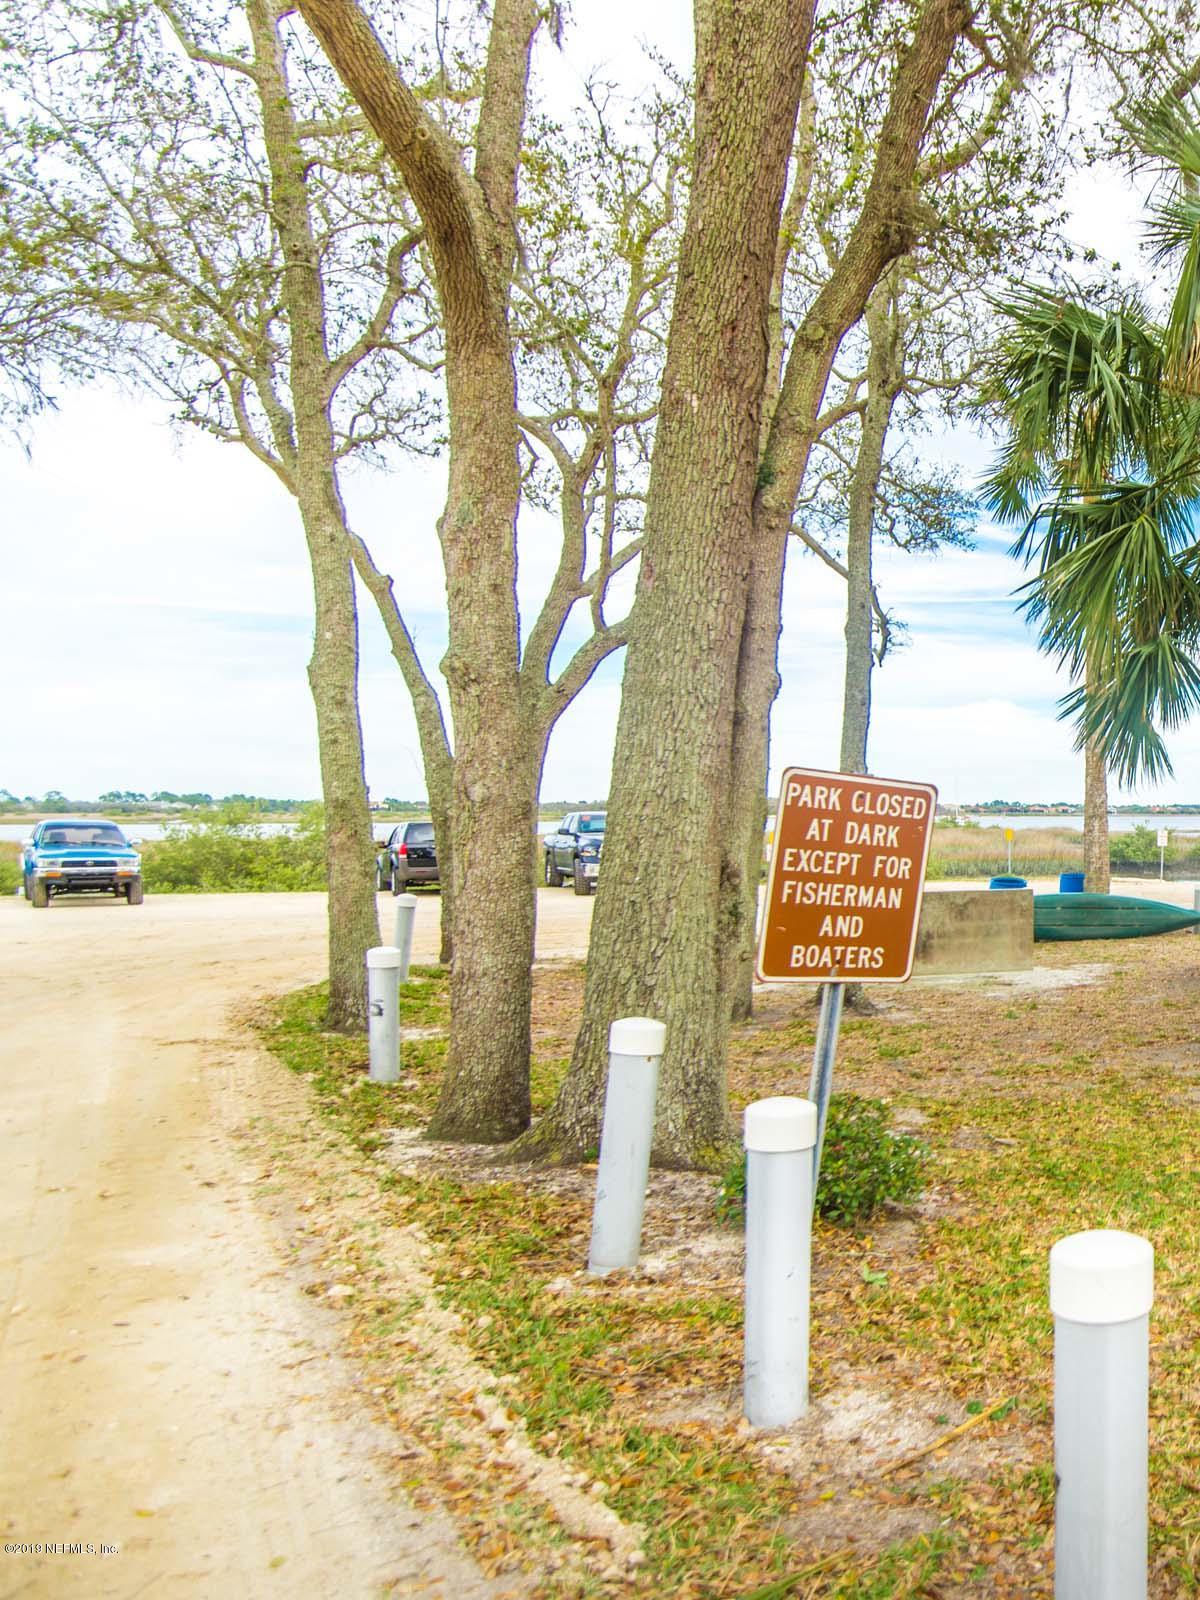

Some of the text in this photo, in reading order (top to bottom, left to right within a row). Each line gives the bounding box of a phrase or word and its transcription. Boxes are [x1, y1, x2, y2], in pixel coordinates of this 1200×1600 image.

[786, 783, 926, 820] PARK CLOSED
[805, 818, 900, 848] AT DARK
[782, 848, 912, 880] EXCEPT FOR
[781, 881, 903, 909] FISHERMAN
[819, 915, 864, 938] AND
[790, 945, 885, 969] BOATERS
